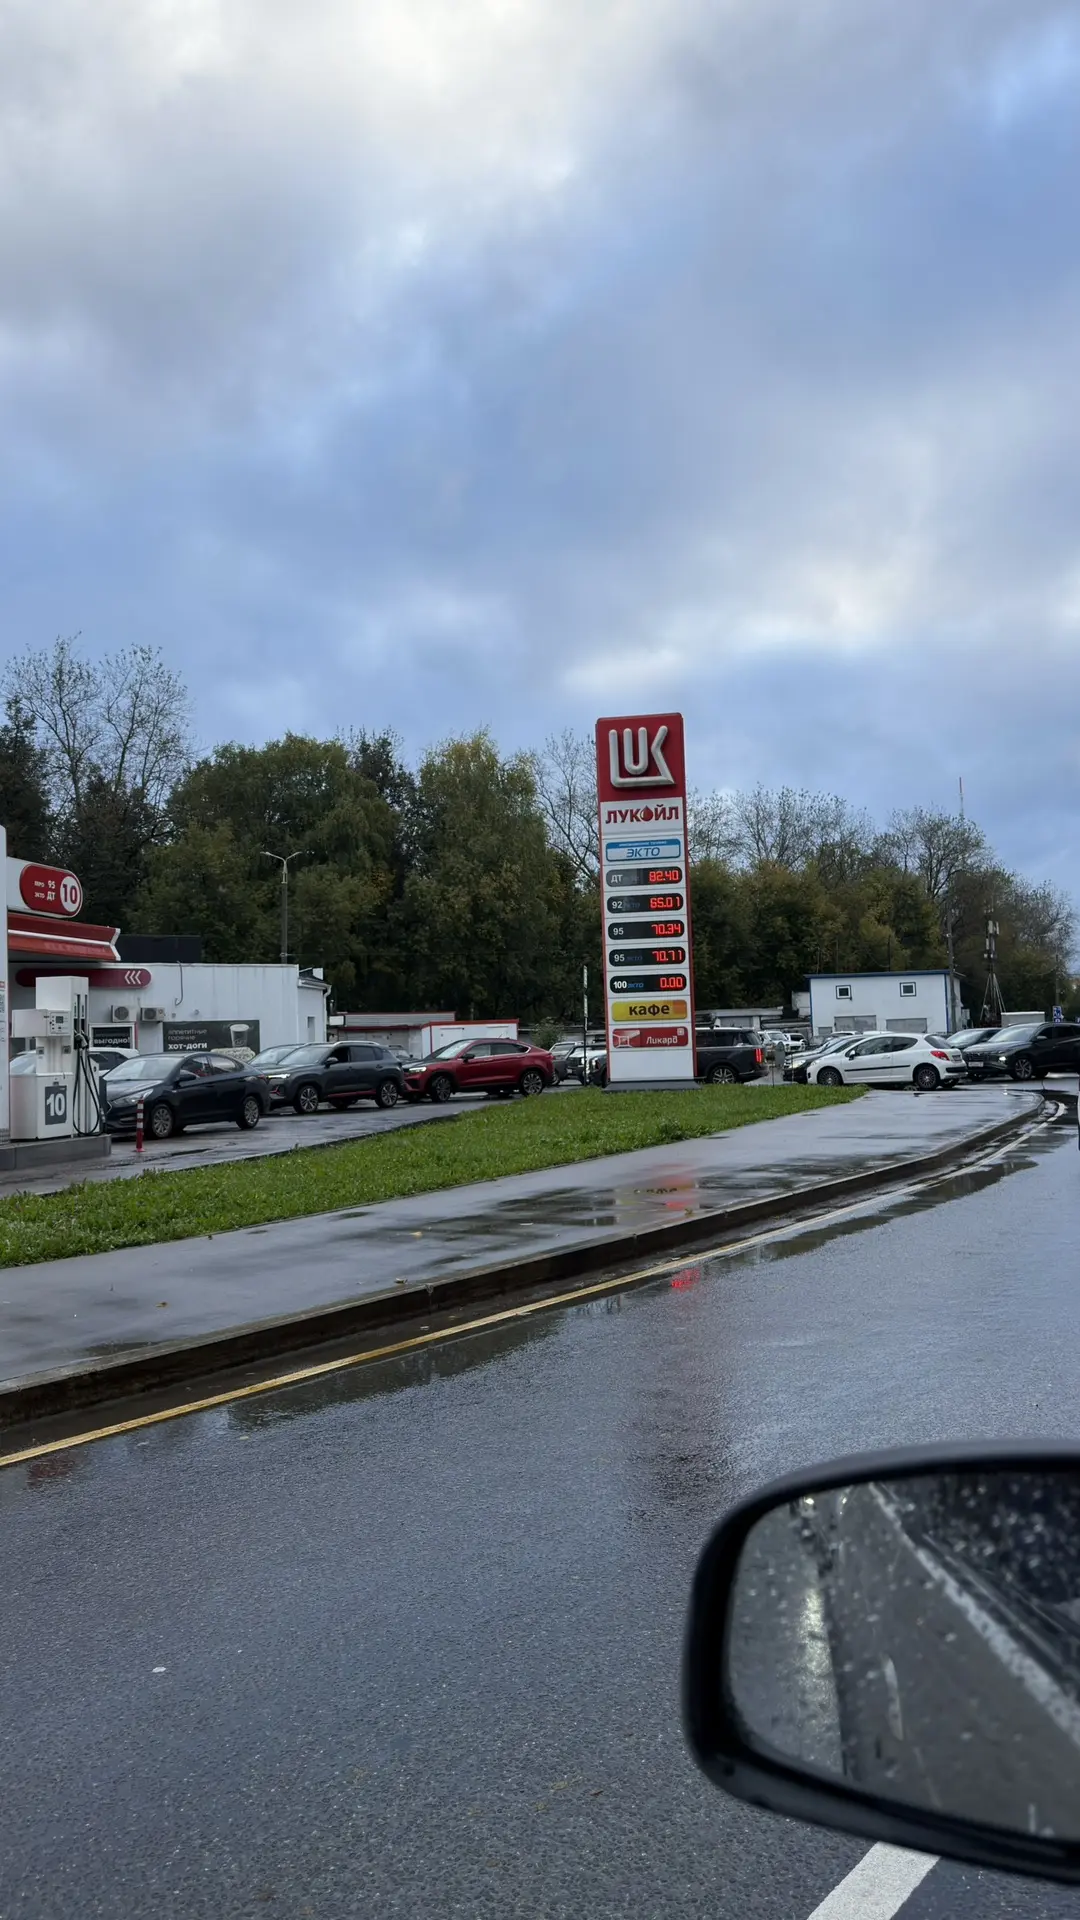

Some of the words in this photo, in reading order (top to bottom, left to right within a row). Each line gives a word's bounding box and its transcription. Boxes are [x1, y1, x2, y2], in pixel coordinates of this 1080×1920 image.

[605, 804, 679, 824] ЛУКОЙЛ
[626, 847, 660, 858] ЭКТО
[610, 874, 624, 884] ДТ
[649, 870, 679, 882] 82.40
[47, 880, 56, 889] 95
[46, 891, 56, 902] ДТ
[62, 883, 78, 904] 10
[611, 900, 623, 909] 92
[650, 896, 680, 909] 65.01
[612, 927, 624, 936] 95
[651, 923, 681, 935] 70.34
[613, 954, 625, 962] 95
[652, 950, 682, 962] 70.71
[613, 980, 628, 989] 100
[660, 976, 683, 989] 0.00
[628, 1003, 670, 1017] кафе
[168, 1042, 208, 1051] хот-доги
[646, 1035, 678, 1046] Ликард
[46, 1093, 66, 1117] 10
